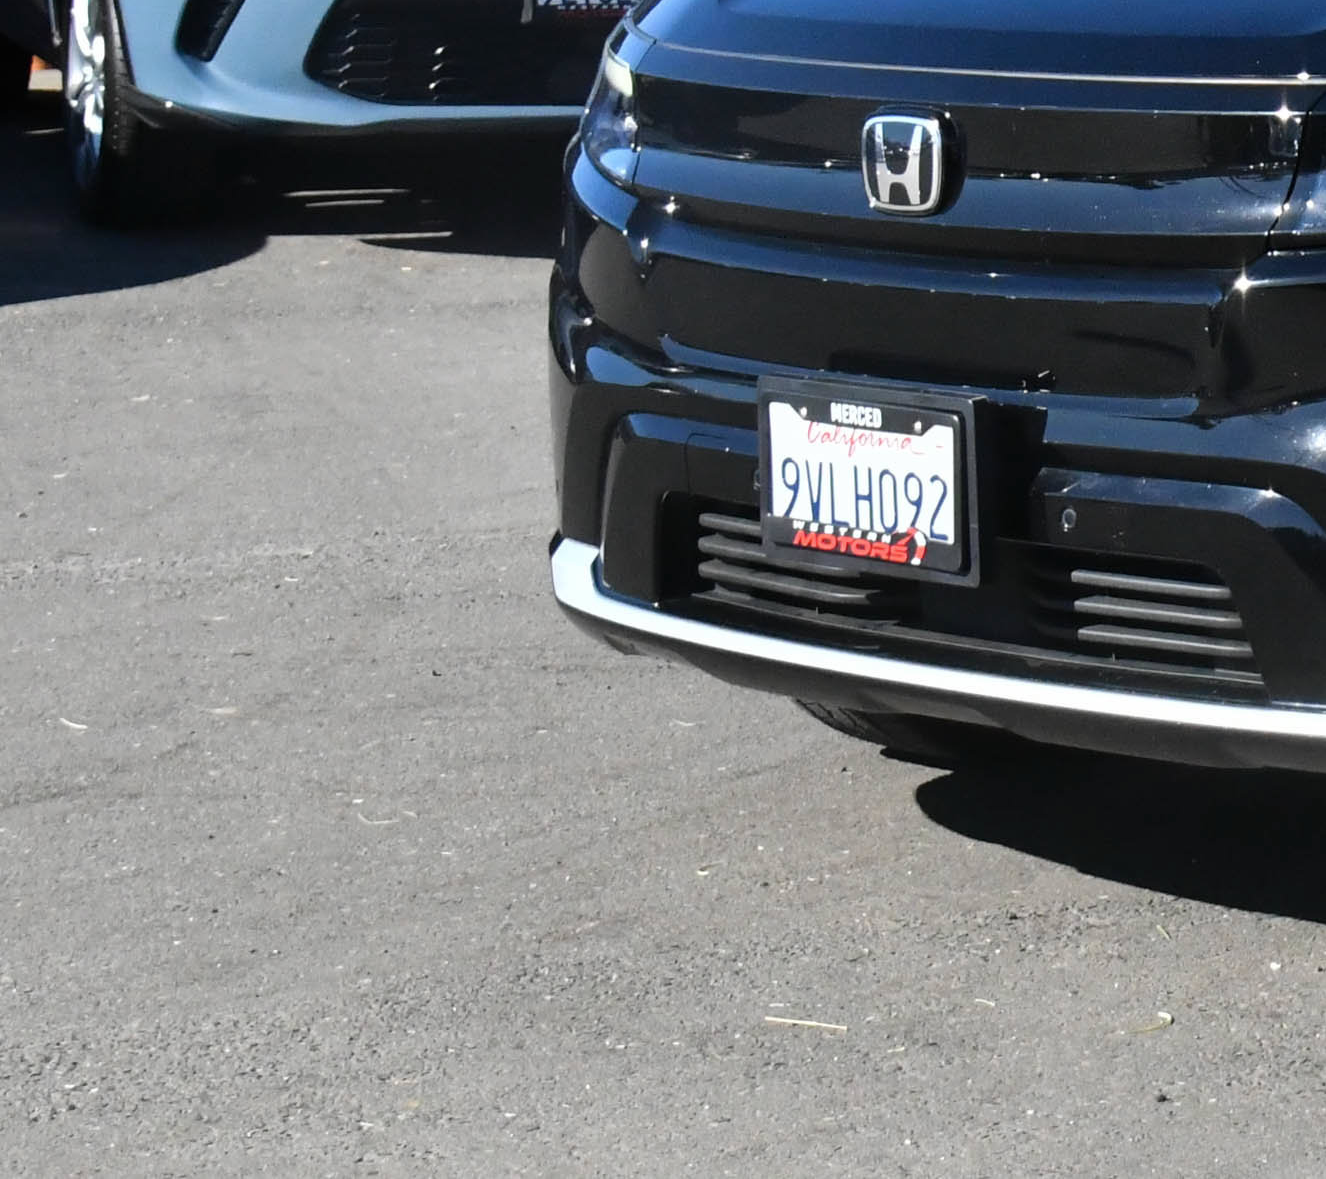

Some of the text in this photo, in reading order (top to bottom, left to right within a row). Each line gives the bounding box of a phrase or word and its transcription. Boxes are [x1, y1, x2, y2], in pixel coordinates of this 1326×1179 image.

[830, 402, 882, 428] MERCED
[807, 421, 925, 457] California
[781, 457, 949, 541] 9VLH092
[793, 530, 909, 563] MOTORS
